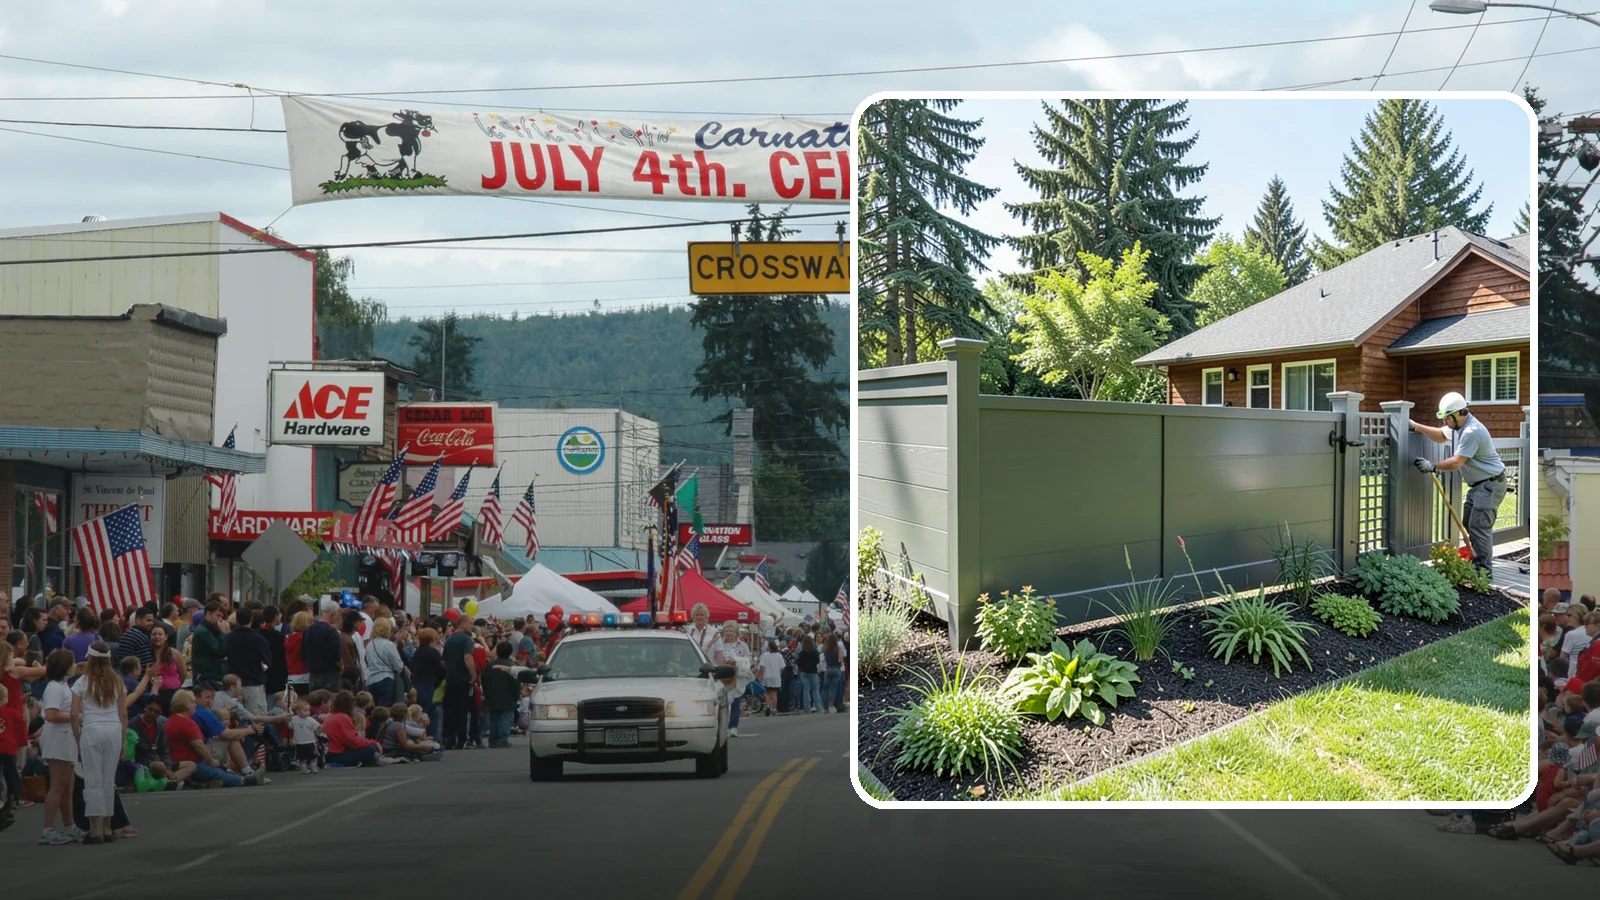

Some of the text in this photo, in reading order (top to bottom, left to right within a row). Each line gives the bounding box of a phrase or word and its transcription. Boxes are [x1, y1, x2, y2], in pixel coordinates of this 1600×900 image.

[480, 141, 604, 193] JULY
[632, 150, 746, 197] 4th.
[697, 254, 850, 280] CROSSWA
[283, 380, 373, 420] ACE
[405, 408, 453, 422] CEDAR
[283, 421, 371, 436] Hardware
[416, 428, 477, 447] Coca-Cola
[353, 467, 387, 481] Simpl
[95, 485, 124, 494] Vincent
[126, 486, 136, 495] de
[137, 486, 155, 495] Paul
[81, 503, 154, 522] THT
[212, 516, 330, 536] HARDARE
[688, 526, 741, 535] CRNATION
[699, 535, 730, 544] GLASS
